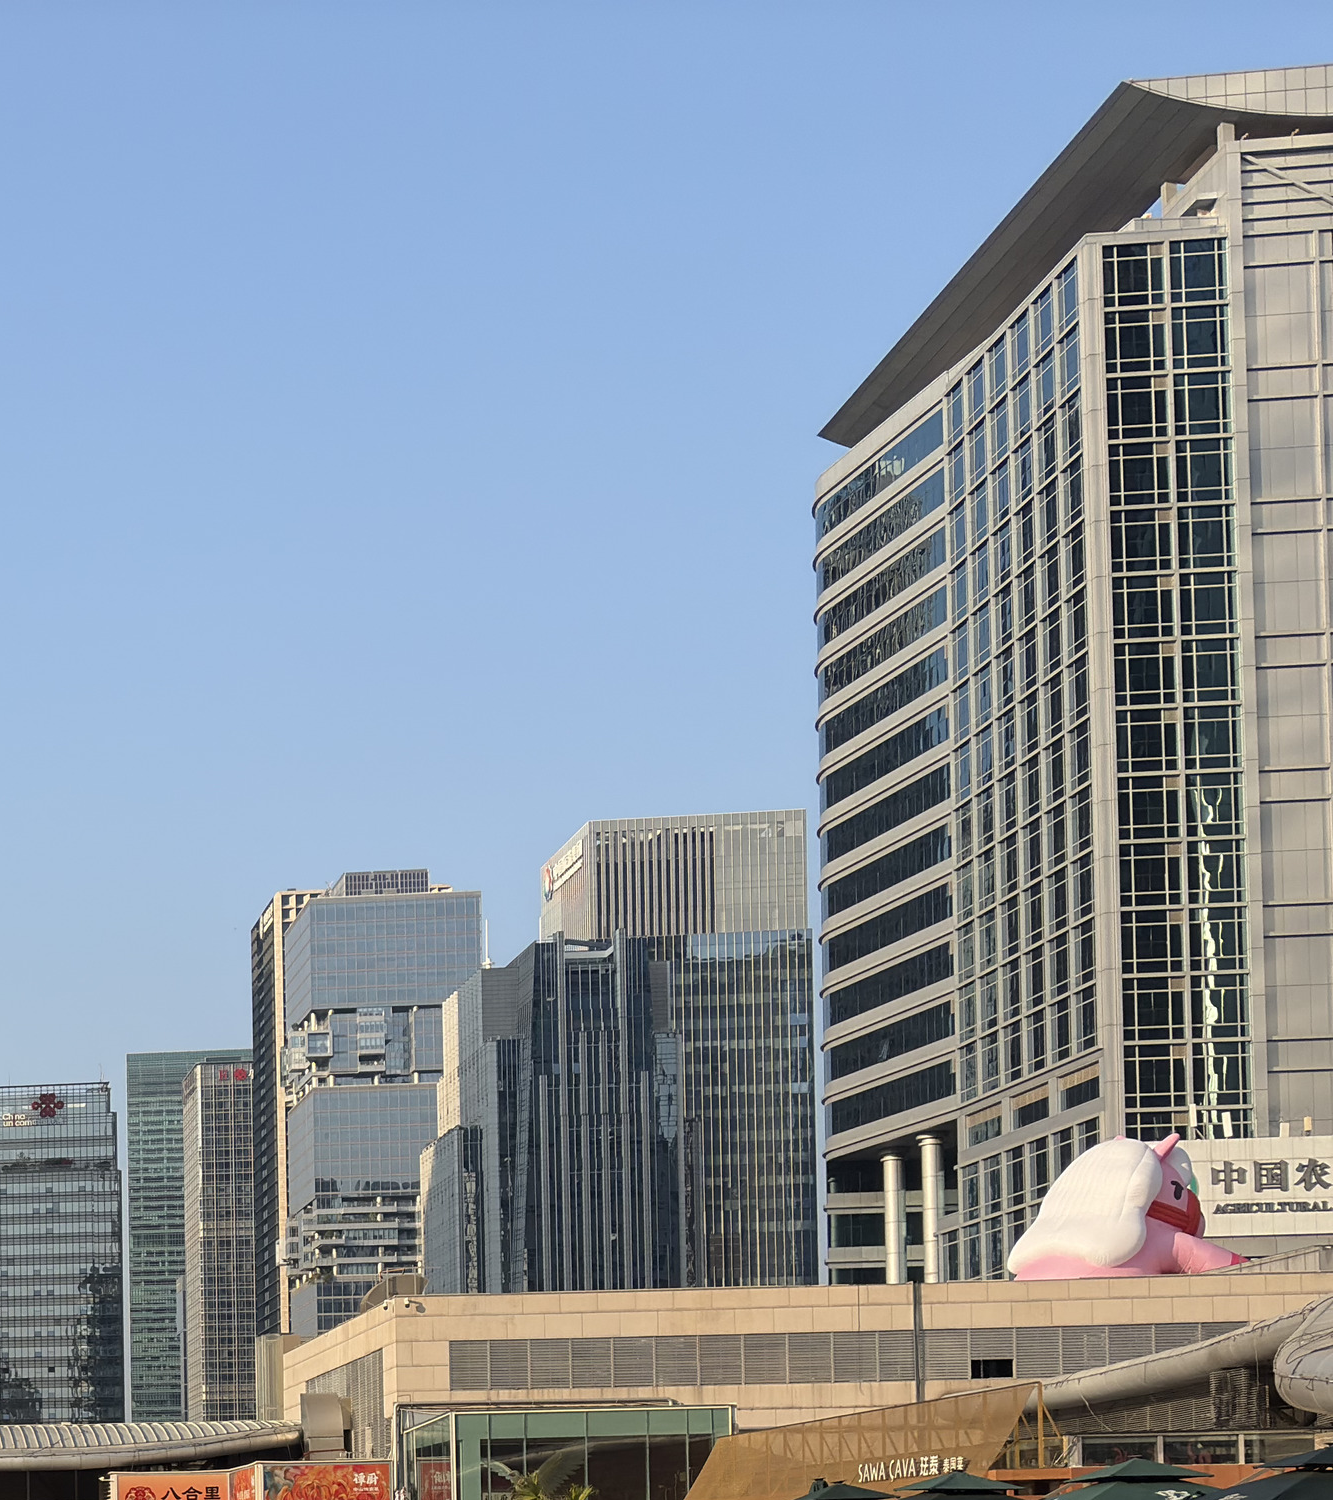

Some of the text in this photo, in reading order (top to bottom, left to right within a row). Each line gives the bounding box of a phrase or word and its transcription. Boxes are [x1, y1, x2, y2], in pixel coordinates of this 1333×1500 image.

[1211, 1158, 1333, 1194] 中国农
[858, 1462, 886, 1483] SAWA
[161, 1486, 221, 1500] 八合里
